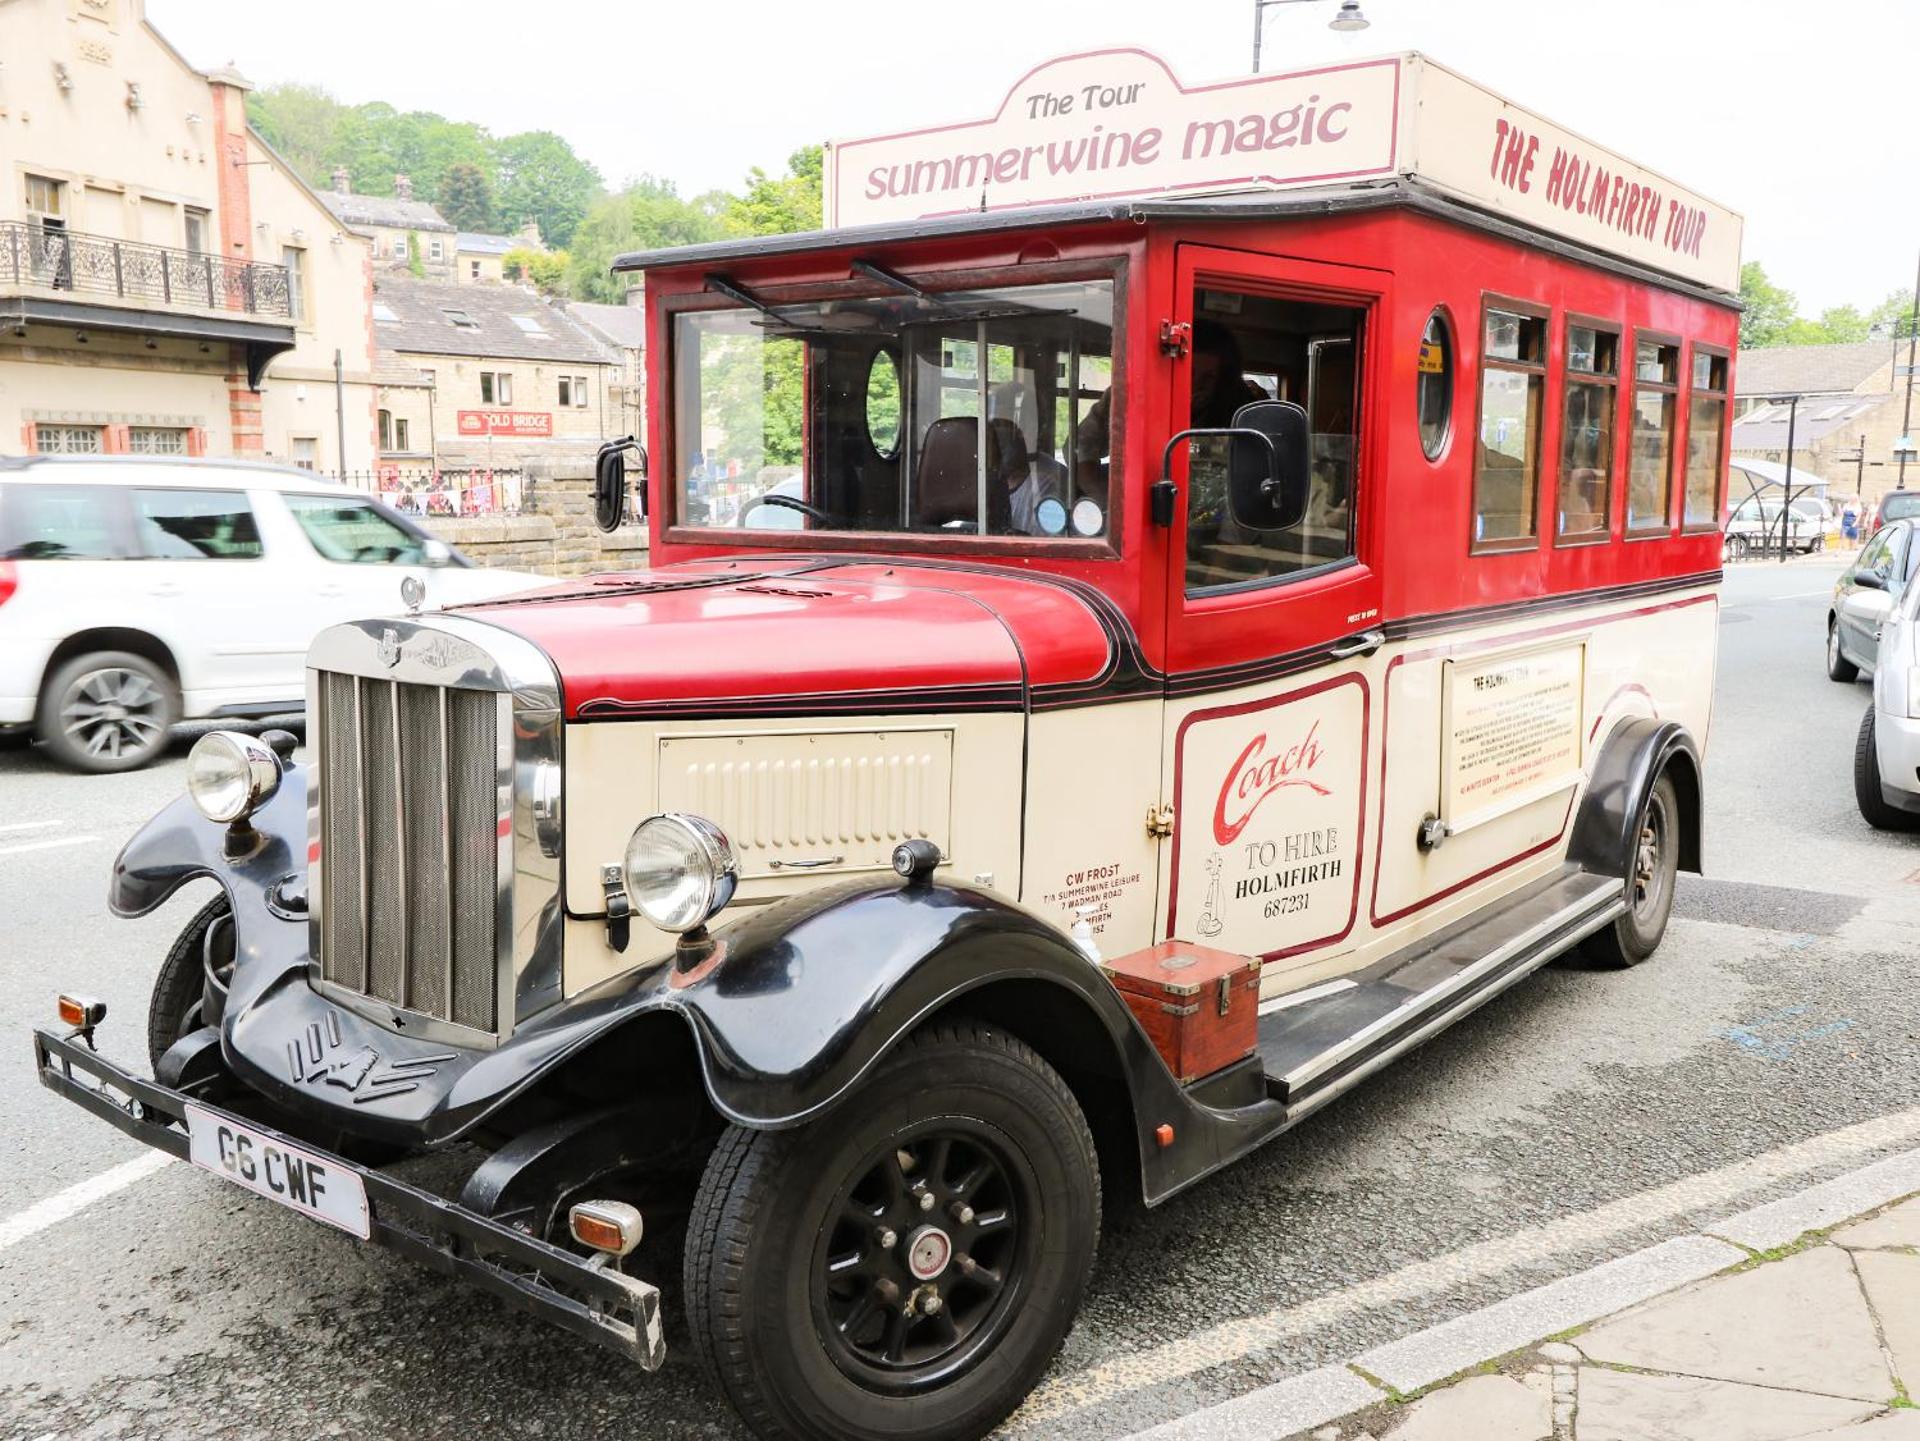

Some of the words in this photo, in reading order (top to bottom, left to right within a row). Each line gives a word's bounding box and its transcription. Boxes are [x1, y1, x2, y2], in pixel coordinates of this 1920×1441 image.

[1026, 93, 1074, 120] The
[1081, 82, 1146, 112] Tour
[864, 124, 1160, 201] summerwine
[1182, 94, 1353, 161] magic
[1490, 118, 1539, 194] THE
[1546, 146, 1661, 242] HOLMFIRTH
[1664, 200, 1706, 260] TOUR
[491, 414, 510, 427] OLD
[513, 414, 548, 427] BRIDGE
[1213, 719, 1332, 847] Coach
[1246, 839, 1276, 870] TO
[1285, 828, 1338, 862] HIRE
[1058, 881, 1109, 900] SUMMERWINE
[1111, 874, 1140, 888] LEISURE
[1066, 872, 1084, 887] CW
[1086, 864, 1120, 882] FROST
[1103, 888, 1122, 901] ROAD
[1236, 860, 1341, 899] HOLMFIRTH
[1264, 893, 1310, 919] 687231
[217, 1125, 257, 1182] G6
[263, 1145, 326, 1209] CWF
